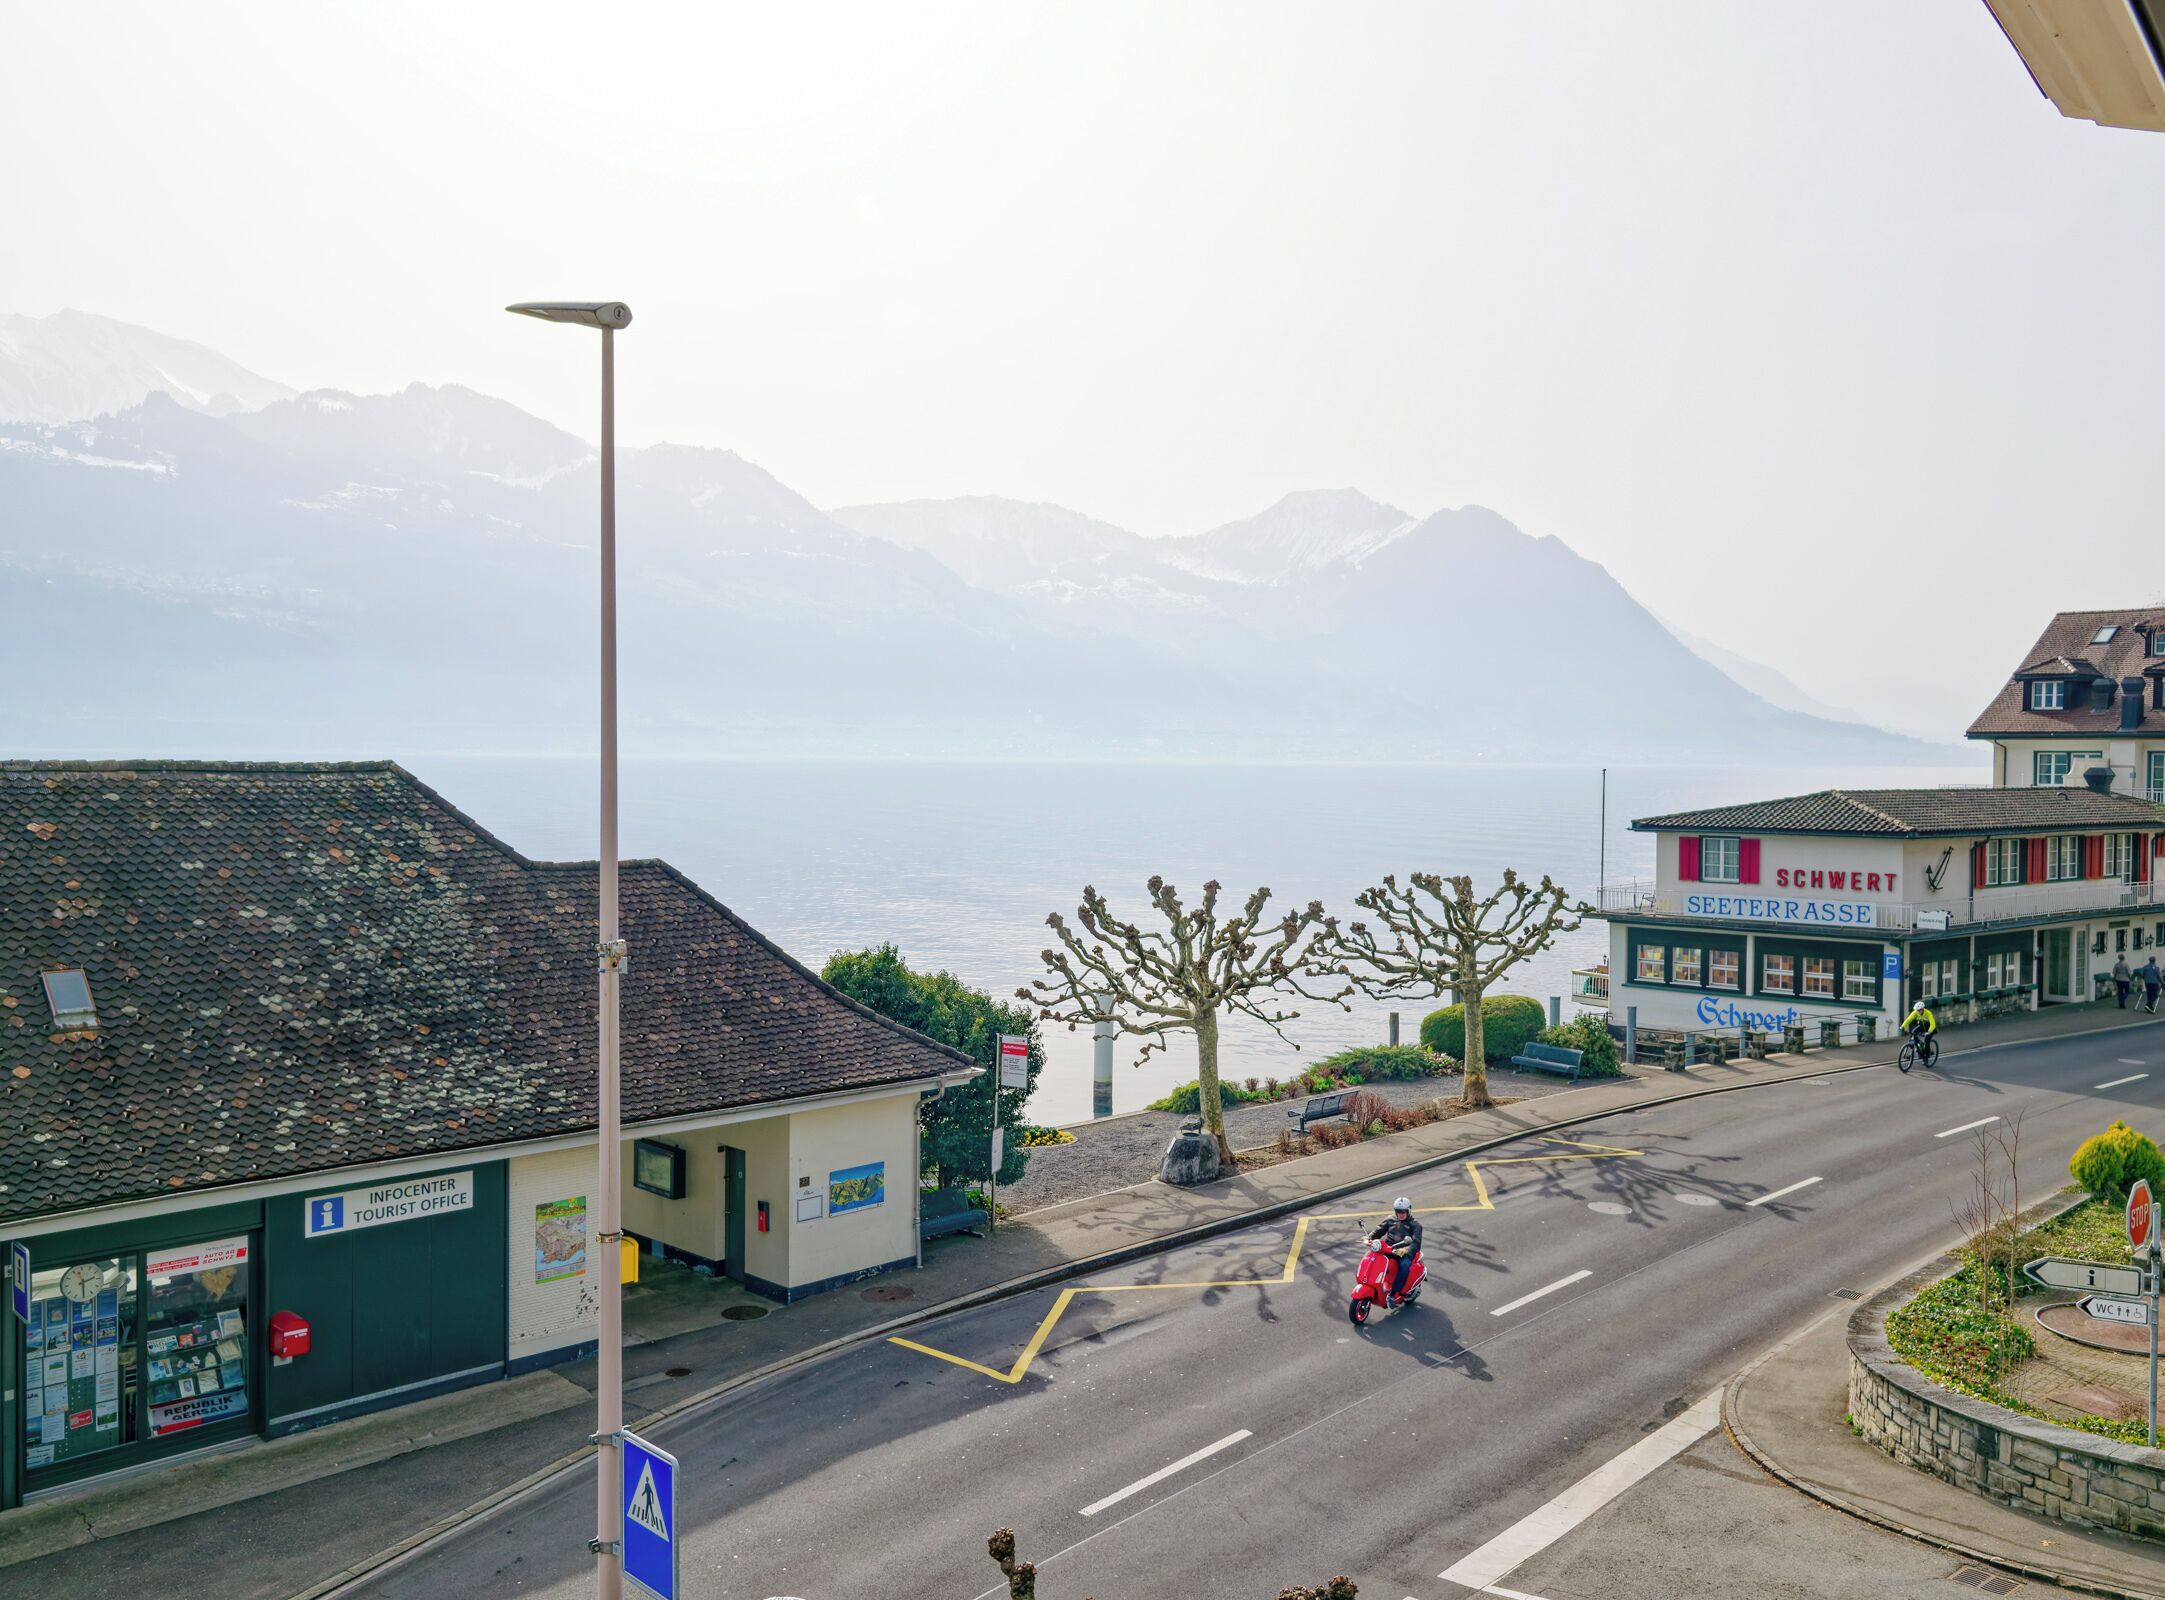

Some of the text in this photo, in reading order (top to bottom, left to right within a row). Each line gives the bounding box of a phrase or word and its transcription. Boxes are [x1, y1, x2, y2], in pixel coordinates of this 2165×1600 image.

[1776, 868, 1897, 892] SCHWERT
[1687, 895, 1872, 924] SEETERRASSE
[1886, 957, 1897, 971] P
[1697, 996, 1798, 1032] Schwert
[369, 1178, 456, 1204] INFOCENTER
[353, 1192, 467, 1223] TOURIST OFFICE
[2130, 1202, 2149, 1229] STOP
[202, 1254, 234, 1264] SCHWYZ
[204, 1251, 223, 1259] AUTO
[2096, 1303, 2114, 1315] WC
[164, 1395, 233, 1417] REPUBLIK
[172, 1405, 229, 1421] GERSAU
